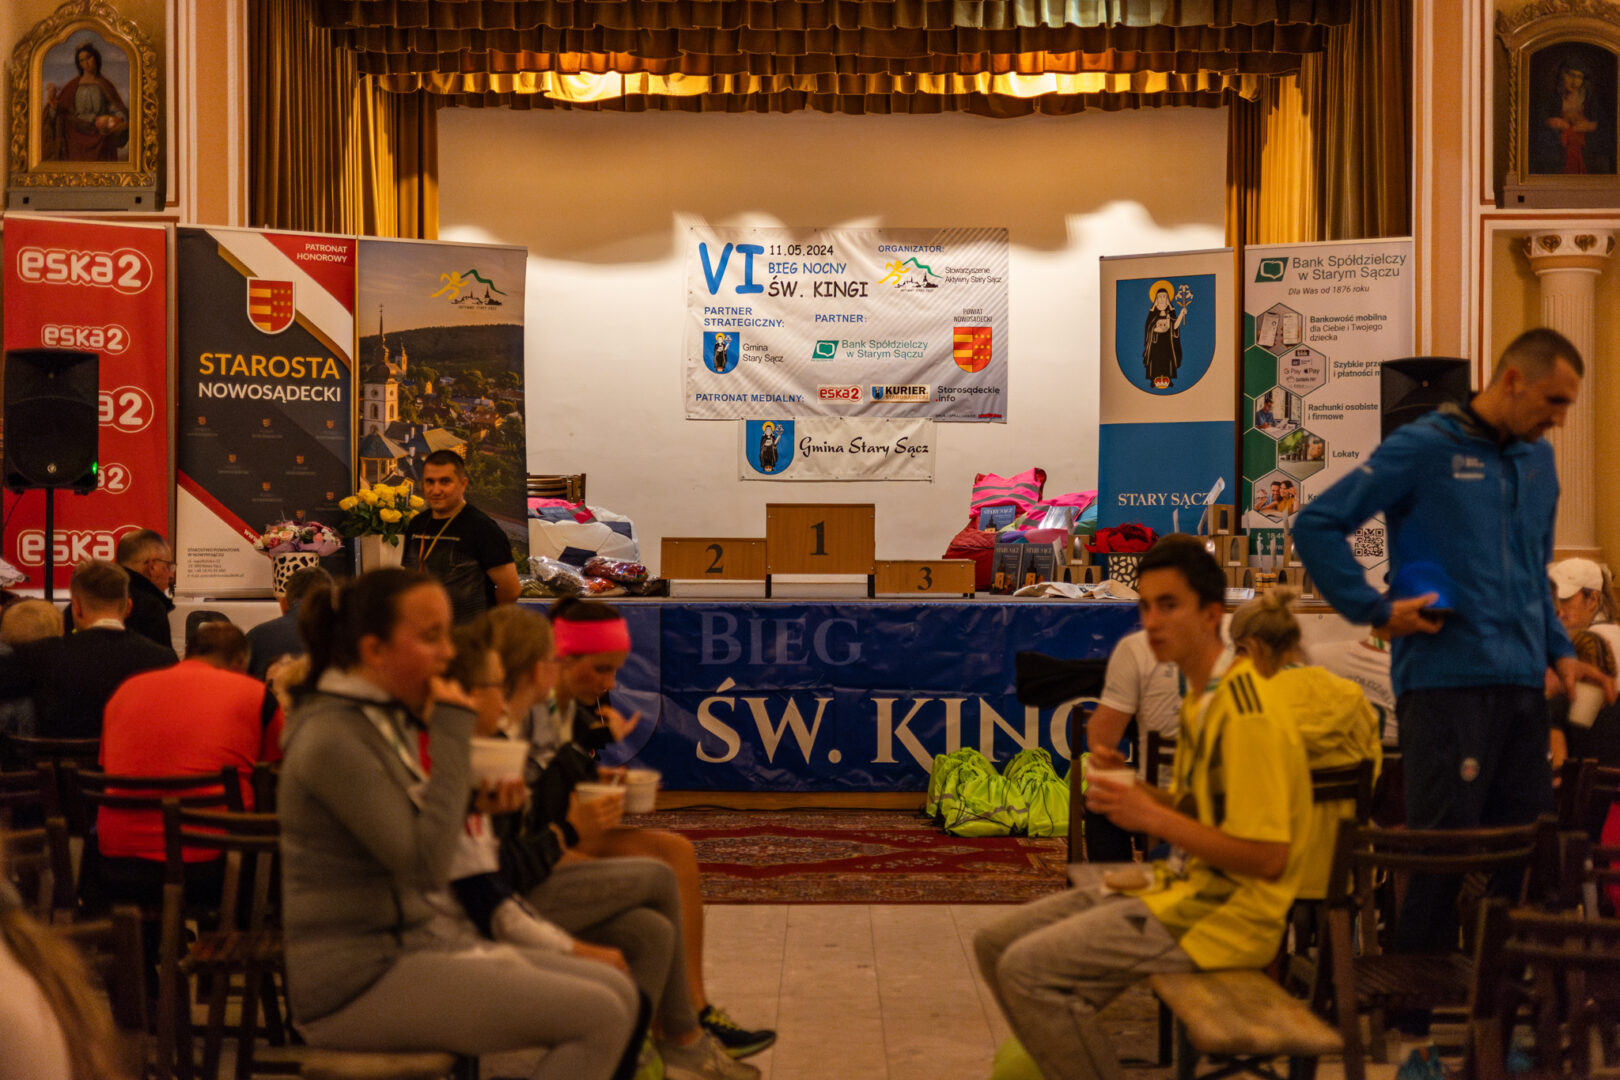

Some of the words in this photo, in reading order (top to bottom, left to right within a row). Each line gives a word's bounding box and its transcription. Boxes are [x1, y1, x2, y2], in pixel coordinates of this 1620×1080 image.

[305, 243, 347, 253] PATRONAT
[770, 244, 834, 256] 11.05.2024
[296, 253, 347, 263] HONOROWY
[1292, 256, 1324, 269] Bank
[1328, 253, 1407, 269] Spółdzielczy
[20, 250, 142, 288] eska2
[698, 242, 765, 295] VI
[768, 262, 798, 274] BIEG
[803, 262, 847, 274] NOCNY
[945, 266, 990, 275] Stowarzyszenie
[1298, 272, 1309, 280] w
[1312, 269, 1356, 282] Starym
[1361, 267, 1400, 280] Sączu
[768, 275, 804, 298] ŚW.
[813, 281, 869, 298] KINGI
[1288, 288, 1301, 296] Dla
[1302, 287, 1318, 295] Was
[1321, 286, 1330, 294] od
[704, 306, 752, 316] PARTNER
[704, 318, 785, 328] STRATEGICZNY:
[815, 314, 867, 323] PARTNER:
[1310, 313, 1354, 323] Bankowość
[1310, 324, 1321, 332] dla
[1323, 324, 1346, 332] Ciebie
[1352, 323, 1382, 333] Twojego
[44, 326, 123, 350] eska2
[1310, 334, 1338, 342] dziecka
[743, 344, 768, 352] Gmina
[842, 340, 865, 348] Bank
[869, 339, 928, 350] Spółdzielczy
[743, 354, 763, 364] Stary
[857, 350, 891, 360] Starym
[894, 350, 924, 360] Sączu
[200, 352, 340, 379] STAROSTA
[1334, 361, 1363, 370] Szybkie
[1366, 361, 1382, 370] prze
[1338, 369, 1372, 379] płatności
[199, 382, 341, 403] NOWOSĄDECKI
[819, 387, 860, 400] eska2
[938, 386, 1000, 395] Starosądeckie
[696, 393, 747, 402] PATRONAT
[750, 394, 804, 403] MEDIALNY:
[800, 436, 844, 457] Gmina
[848, 436, 890, 459] Stary
[894, 436, 929, 457] Sącz
[1332, 450, 1359, 459] Lokaty
[1118, 492, 1167, 506] STARY
[810, 521, 828, 556] 1
[20, 533, 114, 563] eska
[704, 544, 724, 573] 2
[917, 566, 933, 590] 3
[698, 611, 865, 666] BIEG
[696, 677, 842, 764] ŚW.
[870, 697, 1132, 776] KIN
